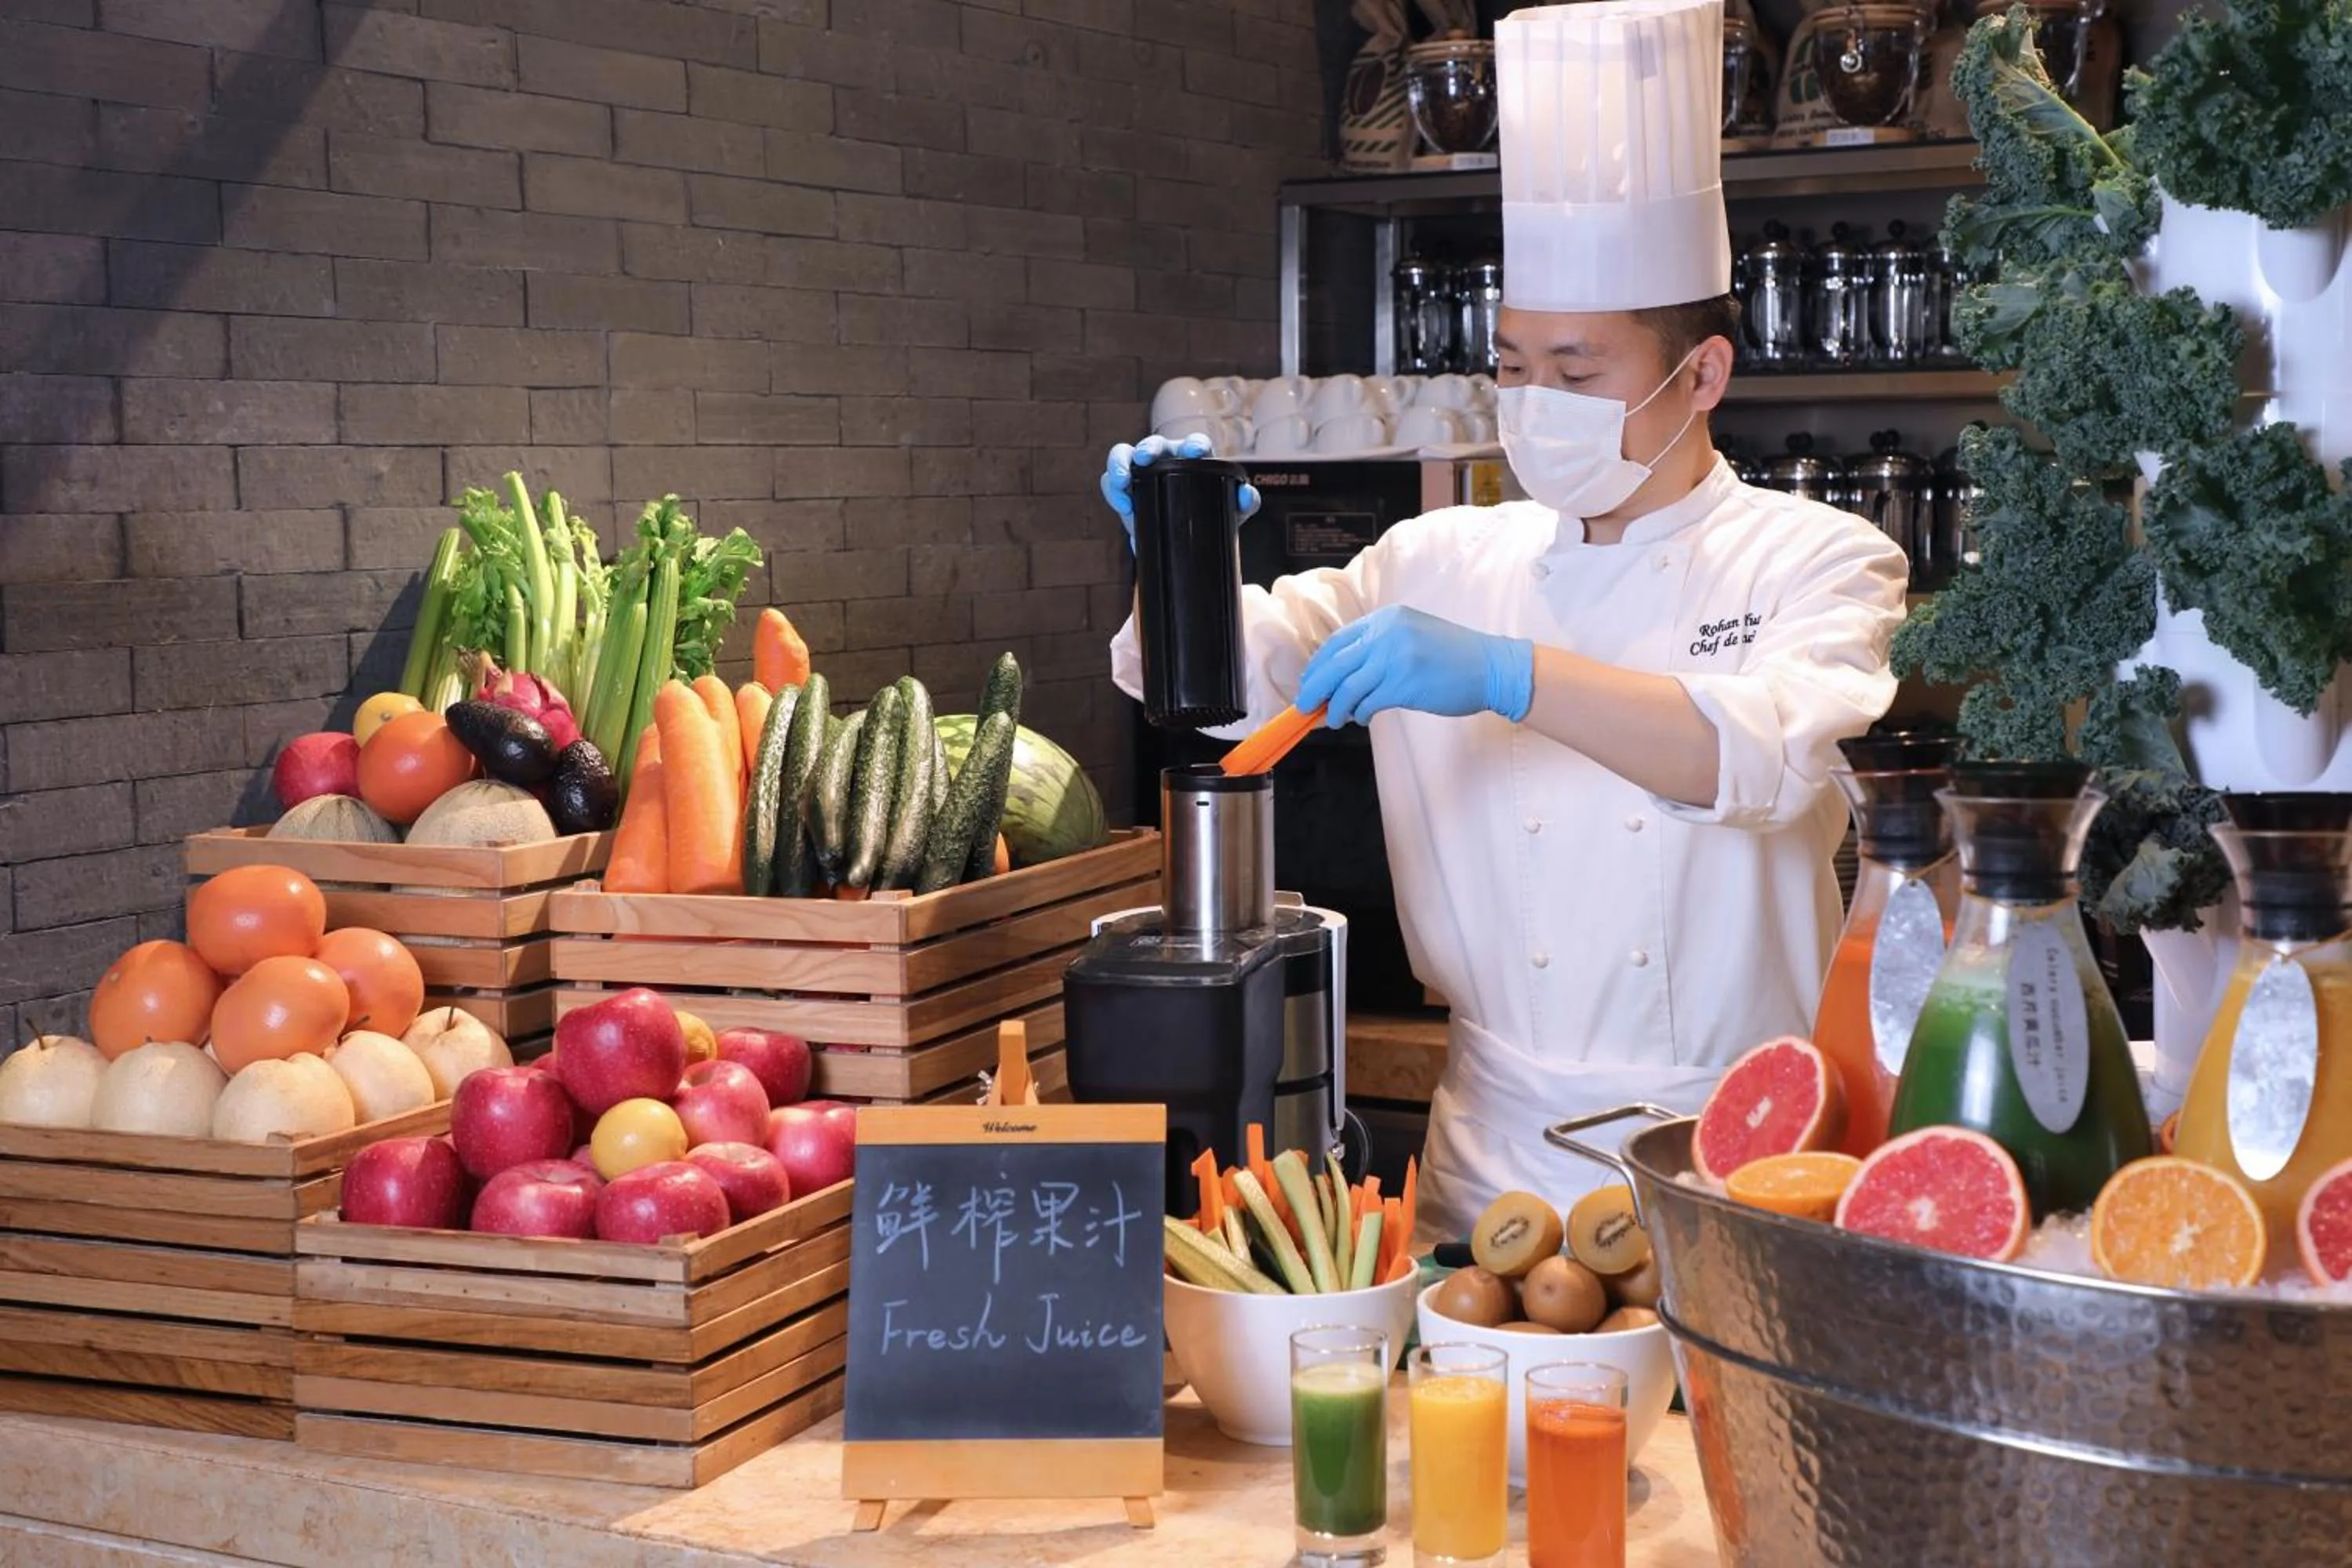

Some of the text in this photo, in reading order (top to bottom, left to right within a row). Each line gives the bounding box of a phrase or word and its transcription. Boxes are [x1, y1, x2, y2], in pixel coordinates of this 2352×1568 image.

[1699, 619, 1739, 637] Rohan
[1690, 636, 1721, 655] Chef
[1724, 632, 1738, 647] de
[982, 1122, 1037, 1133] Welcome
[881, 1293, 1147, 1356] Fresh Juice
